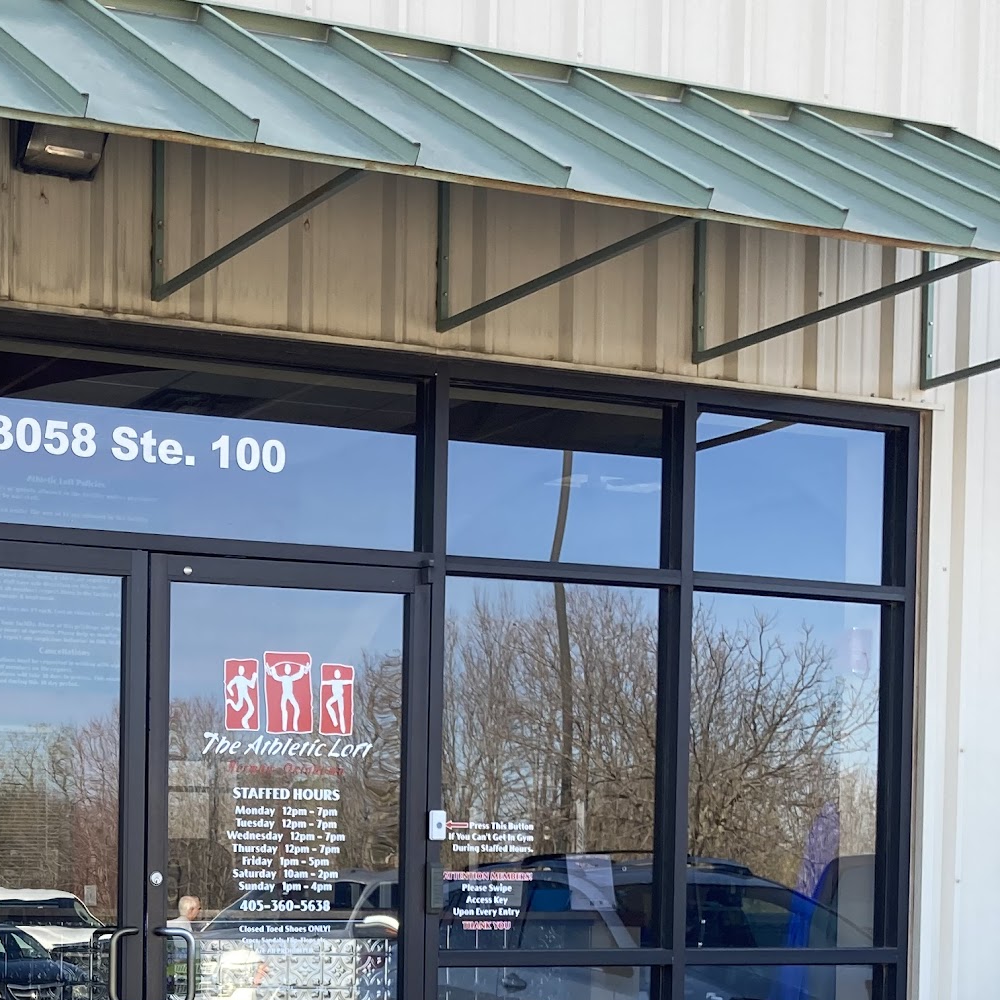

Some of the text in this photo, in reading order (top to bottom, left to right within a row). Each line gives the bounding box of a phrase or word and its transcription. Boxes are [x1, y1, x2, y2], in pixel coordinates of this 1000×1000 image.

[111, 425, 196, 467] Ste.
[211, 435, 287, 474] 100
[202, 731, 373, 758] The Athletic Loft
[232, 787, 341, 801] STAFFED HOURS
[235, 806, 275, 818] Monday
[282, 806, 307, 818] 12pm
[317, 807, 338, 818] 7pm
[235, 818, 275, 830] Tuesday
[281, 819, 307, 830] 12pm
[316, 819, 338, 831] 7pm
[469, 822, 534, 831] Press This Button
[227, 831, 284, 843] Wednesday
[290, 831, 315, 843] 12pm
[324, 832, 346, 843] 7pm
[448, 833, 534, 843] If You Can't Get In Gym
[232, 843, 278, 855] Thursday
[285, 844, 310, 856] 12pm
[319, 844, 340, 856] 7pm
[452, 844, 534, 853] During Staffed Hours.
[242, 856, 273, 868] Friday
[280, 857, 299, 868] 1pm
[308, 857, 330, 868] 5pm
[232, 869, 277, 881] Saturday
[283, 870, 309, 879] 10am
[318, 870, 339, 881] 2pm
[238, 881, 275, 893] Sunday
[282, 882, 301, 893] 1pm
[311, 882, 332, 893] 4pm
[461, 883, 512, 894] Please Swipe
[239, 900, 331, 912] 405-360-5638
[465, 896, 508, 905] Access Key
[452, 908, 520, 917] Upon Every Entry
[239, 925, 331, 933] Closed Toed Shoes ONLY!
[462, 921, 512, 931] THANK YOU
